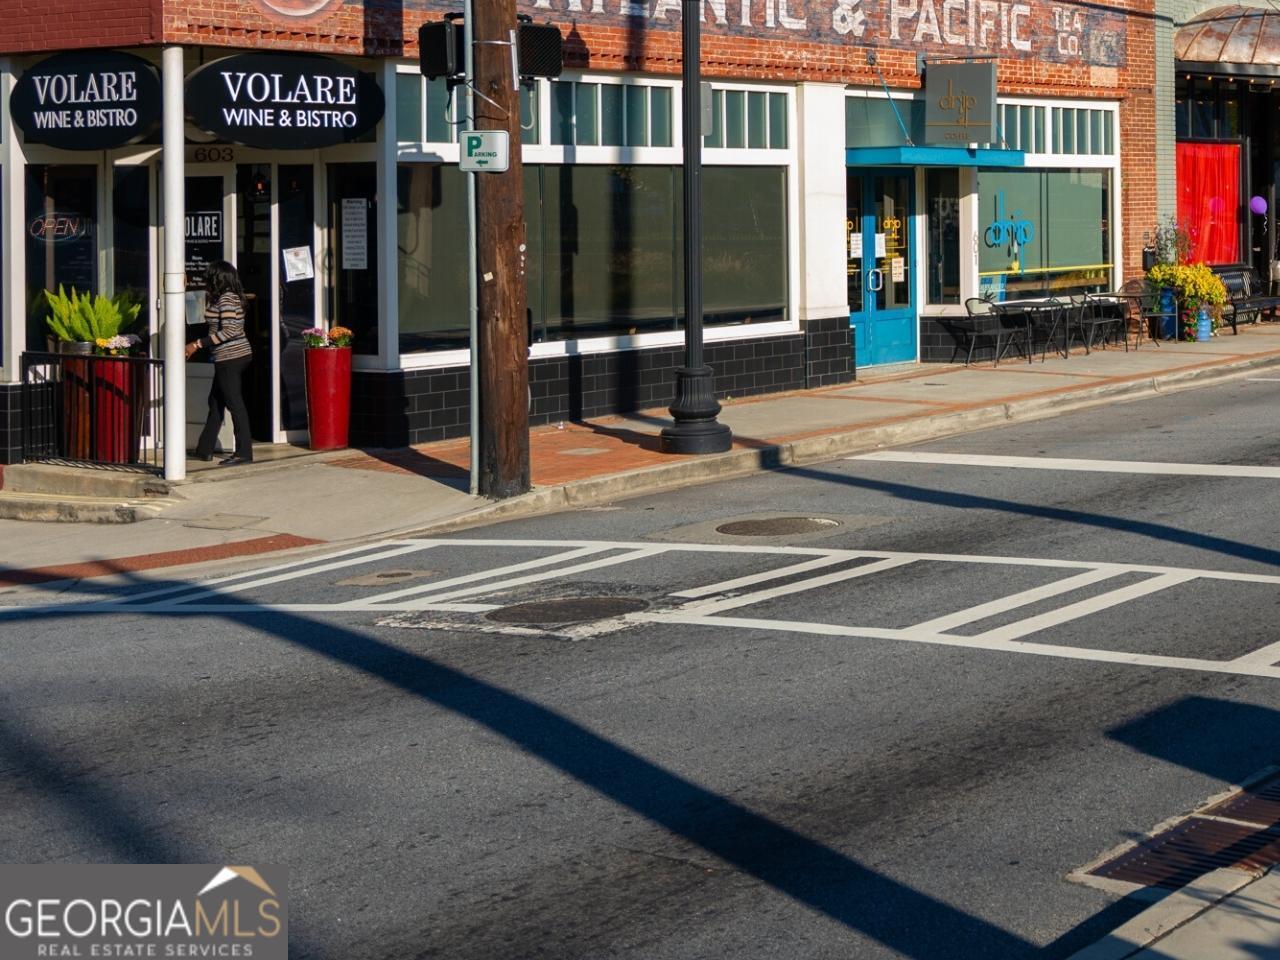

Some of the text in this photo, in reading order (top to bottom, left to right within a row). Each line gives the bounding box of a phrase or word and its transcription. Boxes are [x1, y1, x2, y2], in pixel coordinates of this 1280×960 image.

[1052, 7, 1083, 32] TEA
[32, 71, 137, 105] VOLARE
[220, 71, 357, 105] VOLARE
[34, 108, 138, 129] WINE & BISTRO
[223, 108, 357, 129] WINE & BISTRO
[194, 146, 235, 163] 603
[467, 136, 498, 157] PARKING
[31, 218, 80, 237] OPEN
[185, 215, 218, 238] OLARE
